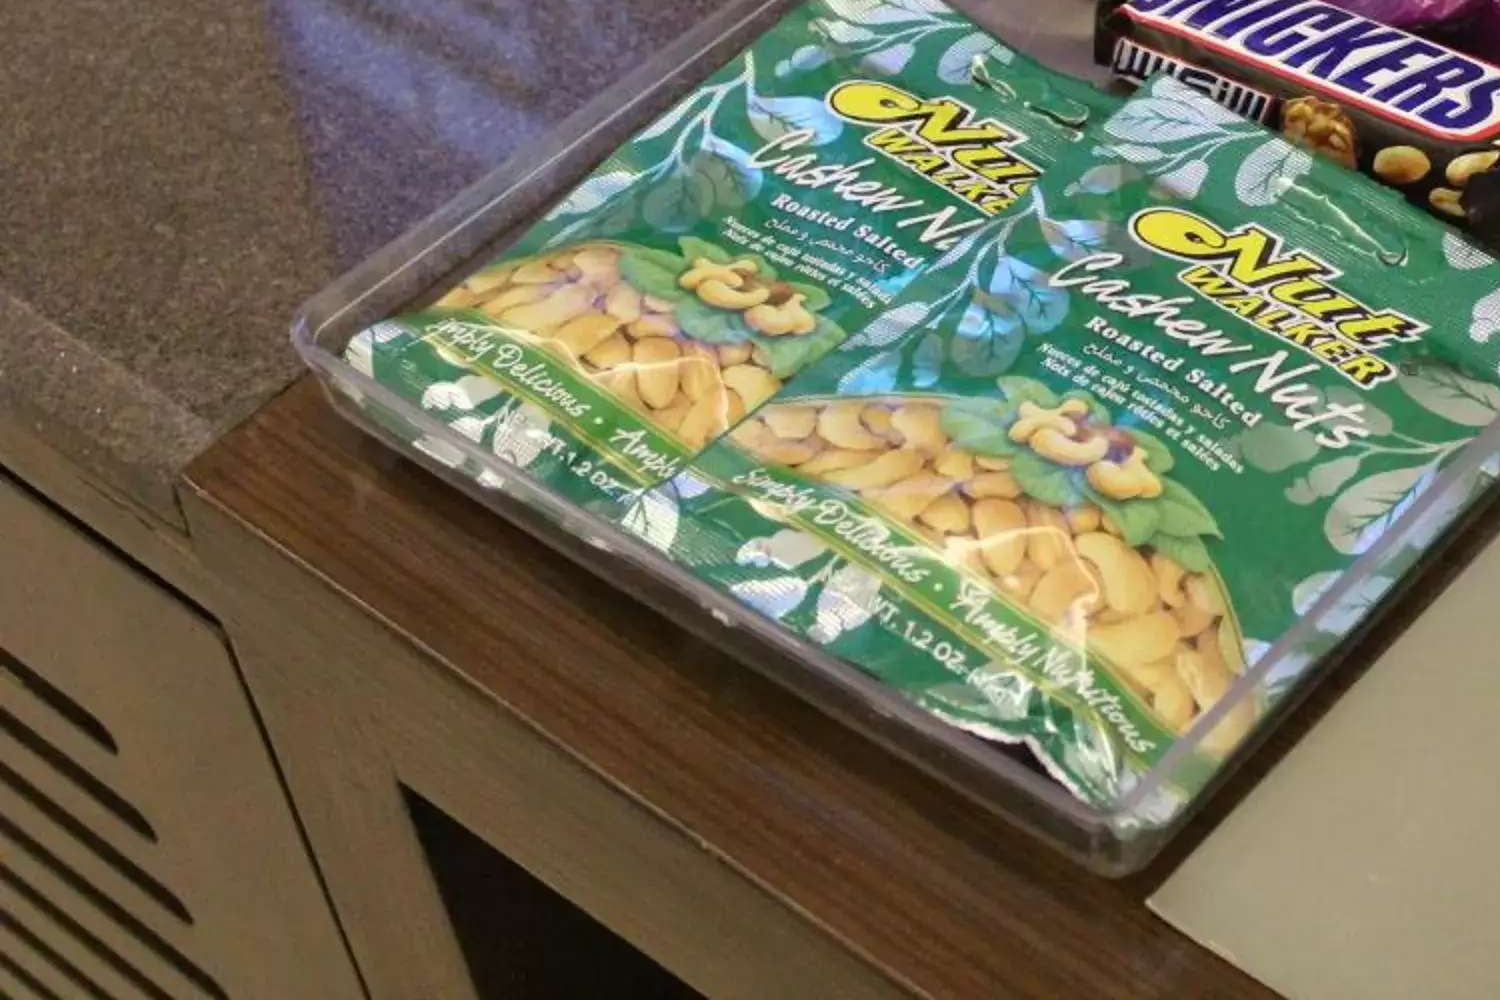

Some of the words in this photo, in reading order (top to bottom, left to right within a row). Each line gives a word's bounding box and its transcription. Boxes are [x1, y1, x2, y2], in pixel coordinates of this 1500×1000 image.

[748, 128, 924, 213] Cashew
[771, 192, 856, 232] Roasted
[853, 223, 925, 269] Salted
[1048, 252, 1253, 357] Cashew
[1228, 349, 1370, 449] Nuts
[1083, 364, 1100, 377] de
[1083, 315, 1185, 373] Roasted
[1184, 367, 1263, 427] Salted
[1181, 266, 1394, 388] WALKER
[492, 342, 592, 418] Delicious
[813, 499, 932, 584] Delicious
[1032, 645, 1158, 753] Nutritious
